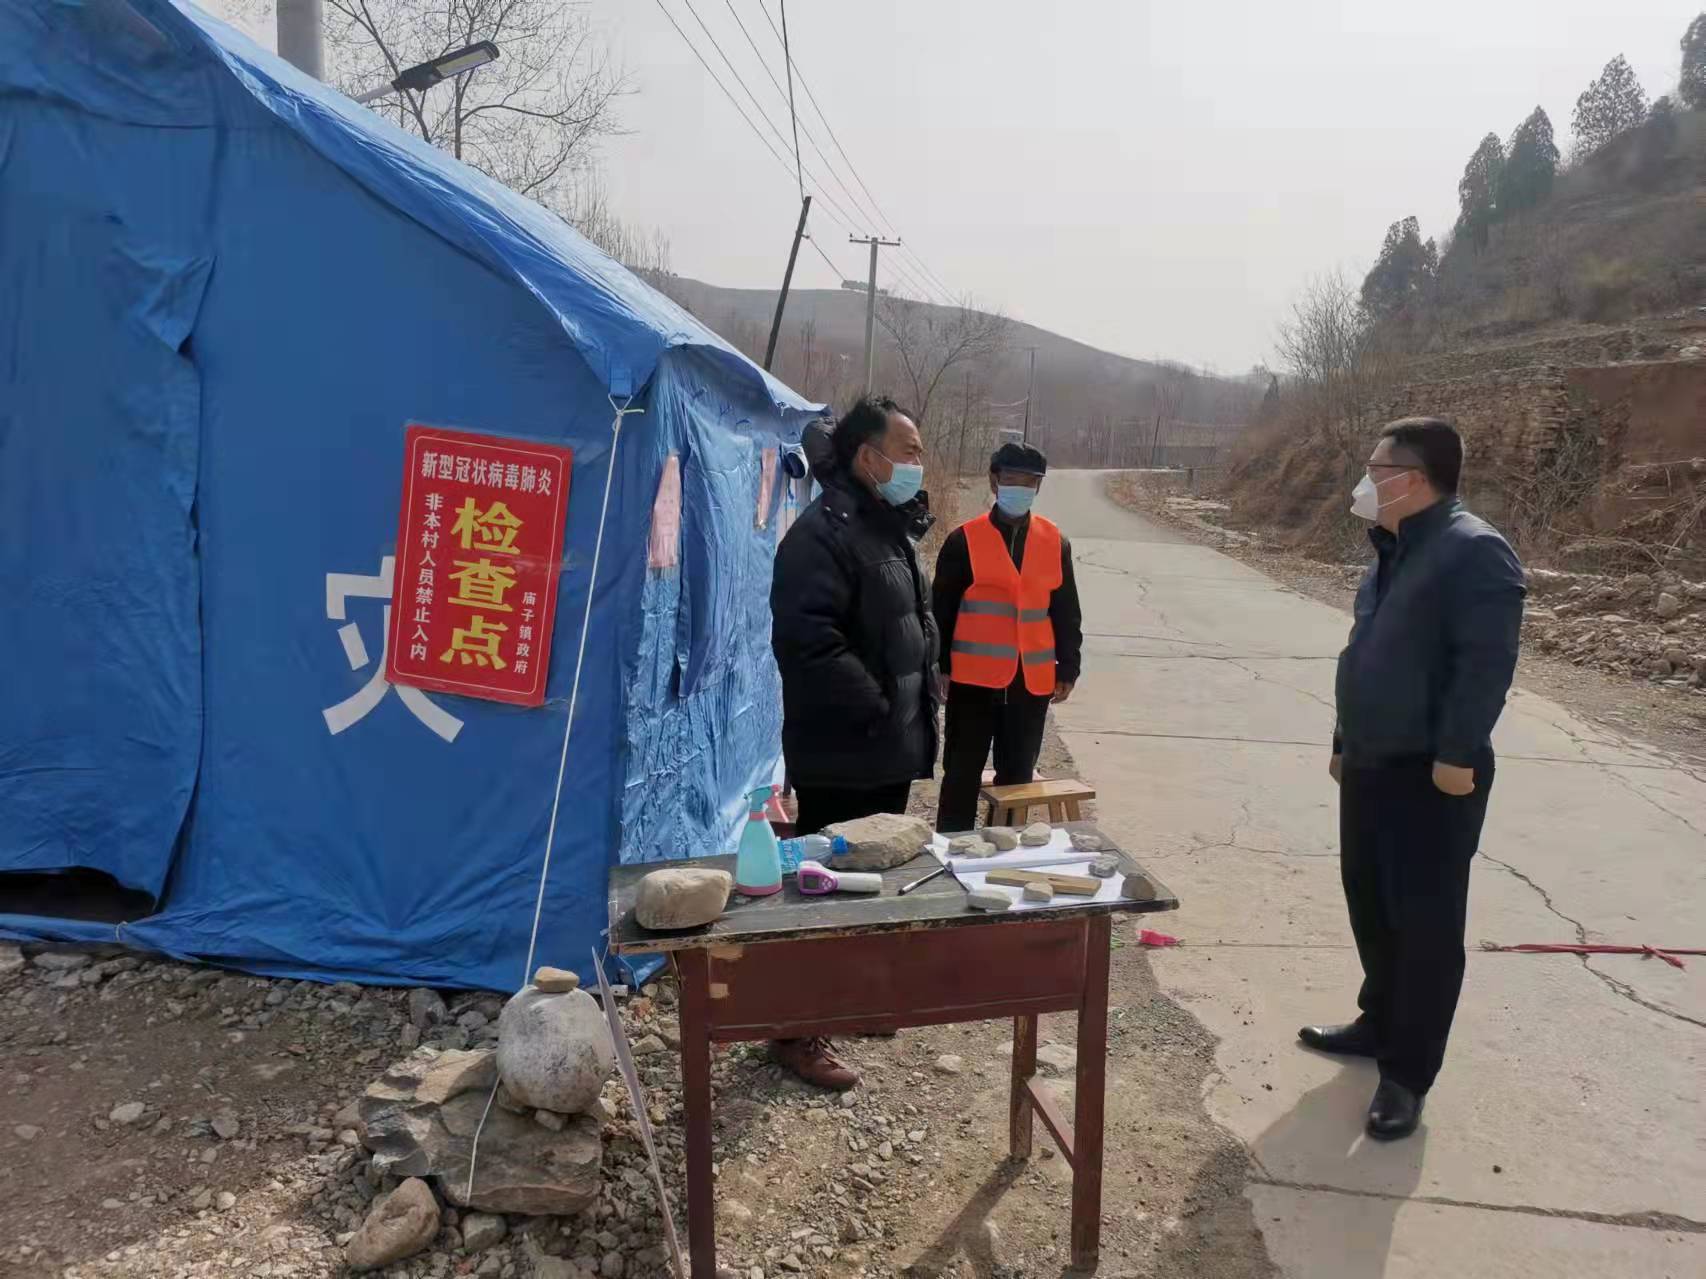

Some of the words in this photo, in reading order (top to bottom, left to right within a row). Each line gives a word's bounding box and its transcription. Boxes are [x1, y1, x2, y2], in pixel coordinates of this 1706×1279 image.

[421, 451, 552, 496] 新型冠状病毒肺炎
[410, 493, 443, 661] 非本村人员禁止入内
[440, 497, 524, 670] 检查点
[513, 591, 536, 674] 庙子镇政府
